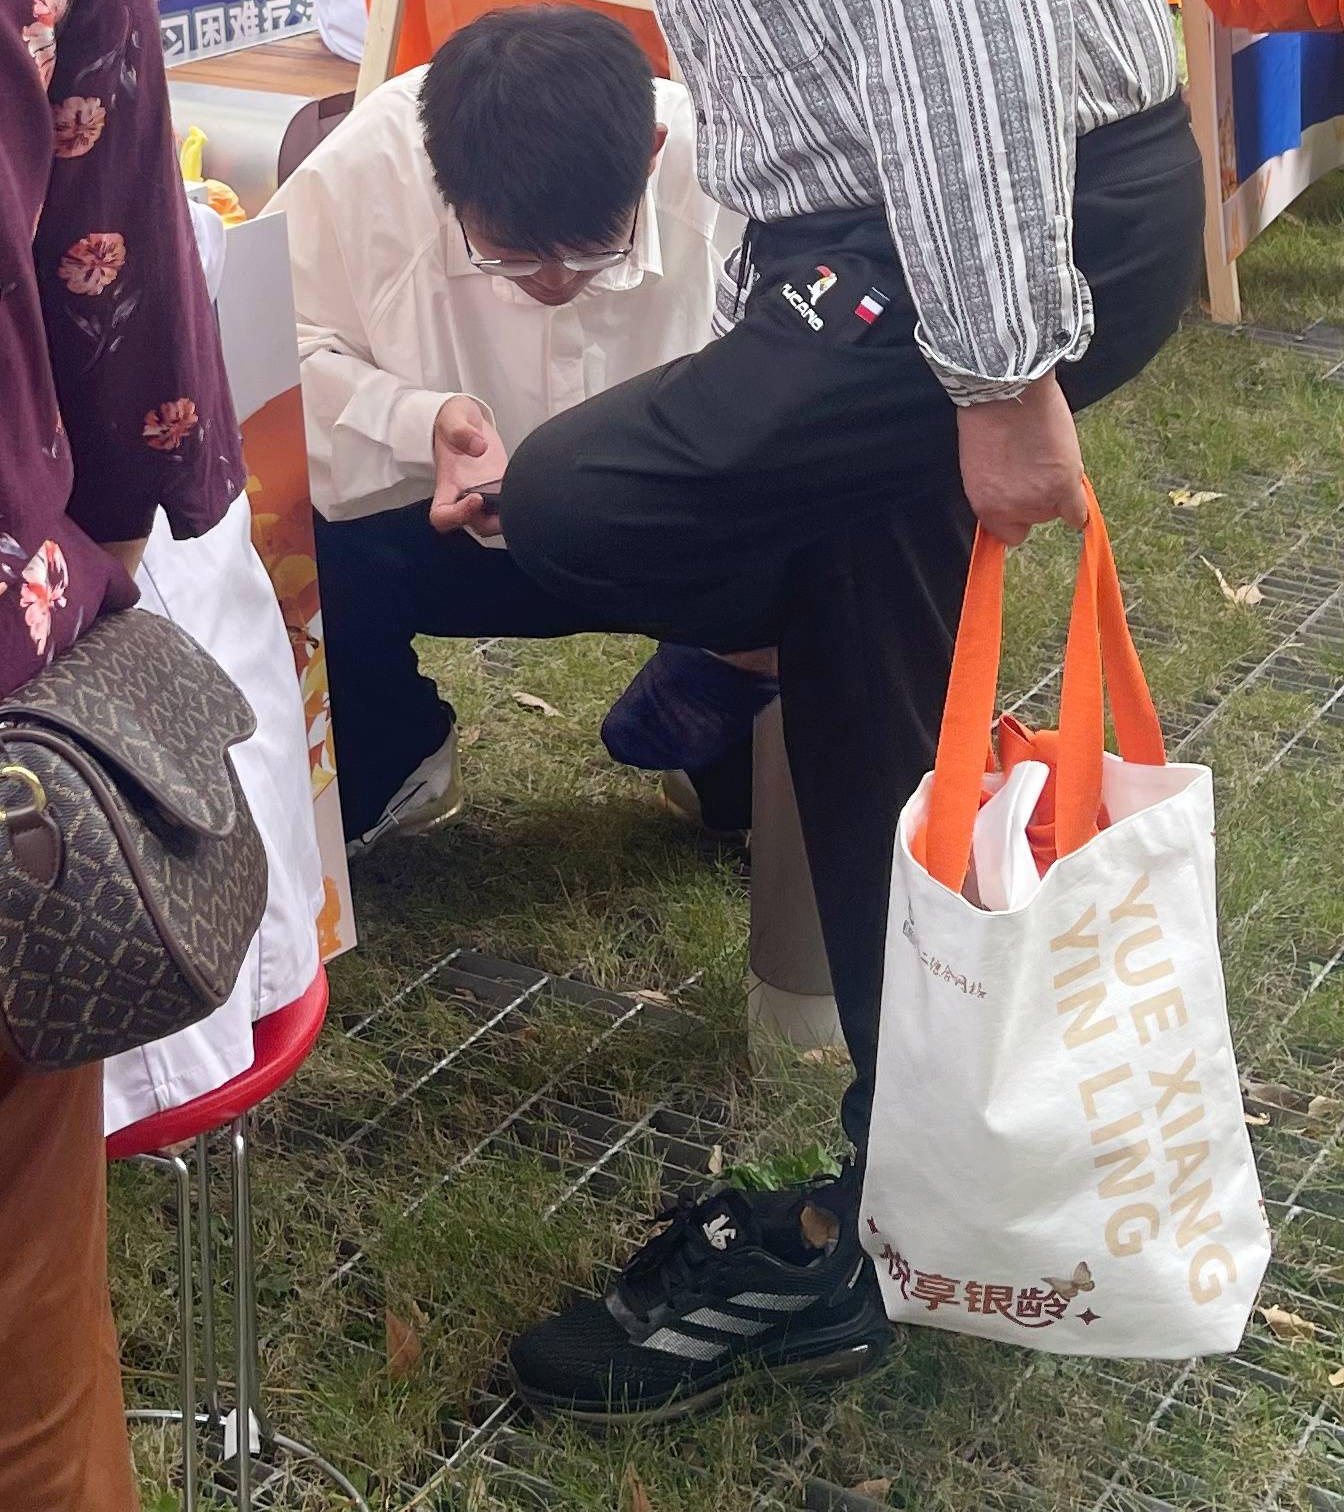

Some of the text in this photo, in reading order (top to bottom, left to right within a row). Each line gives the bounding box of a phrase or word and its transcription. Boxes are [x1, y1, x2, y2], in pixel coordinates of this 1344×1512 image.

[1049, 903, 1161, 1259] YIN LING
[1108, 871, 1238, 1305] YUE XIANG
